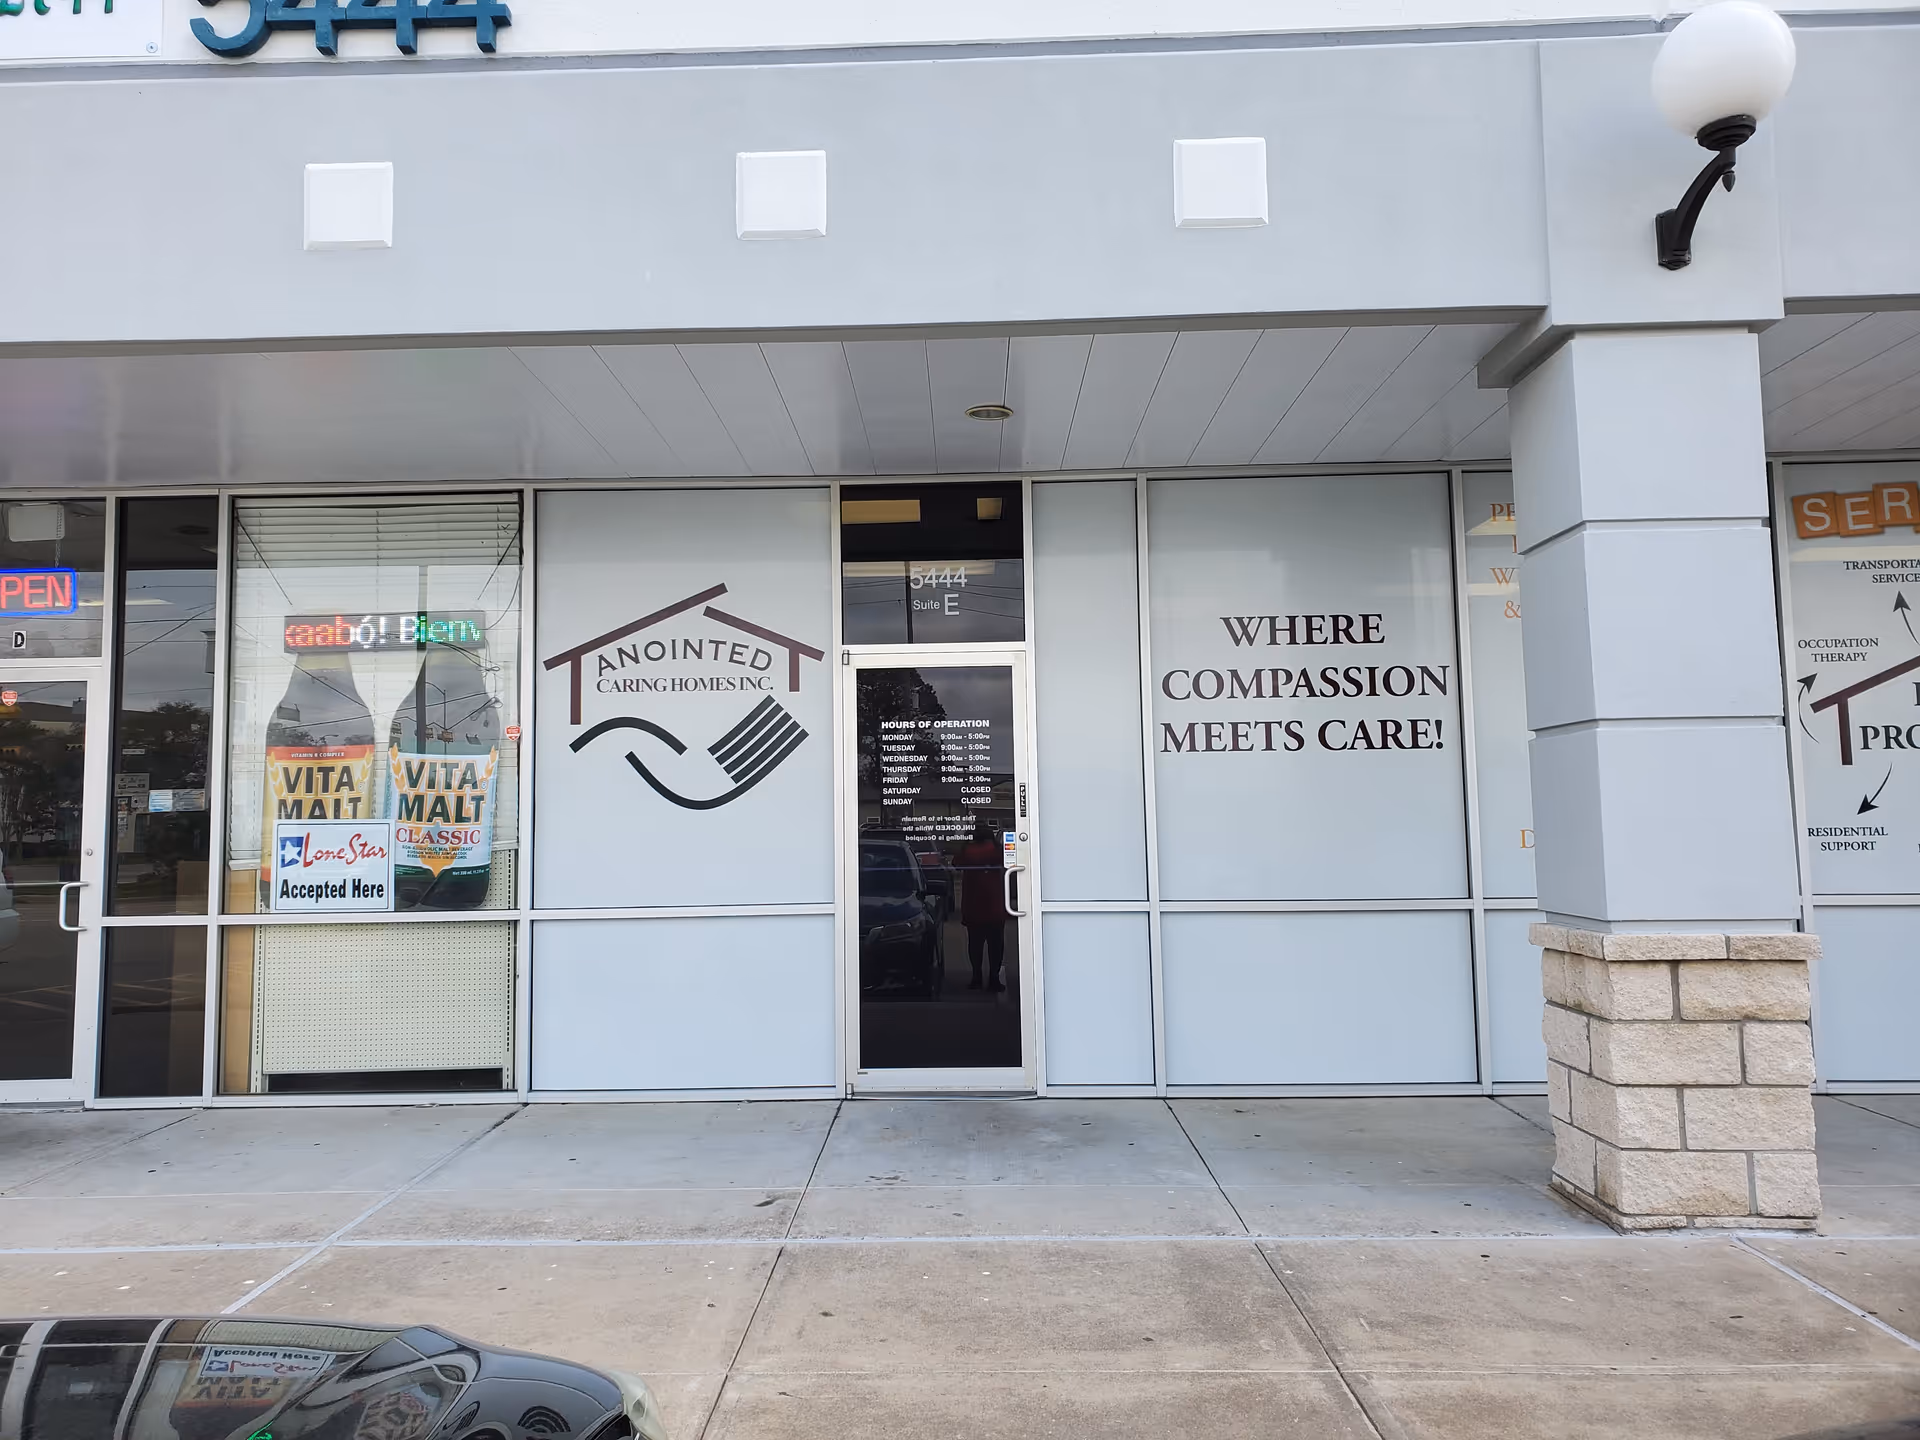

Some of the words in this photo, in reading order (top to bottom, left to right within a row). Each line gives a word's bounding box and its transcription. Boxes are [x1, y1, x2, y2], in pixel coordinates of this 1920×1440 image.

[910, 566, 968, 590] 5444
[913, 600, 940, 610] Suite
[944, 594, 960, 616] E
[14, 632, 25, 648] D
[1220, 614, 1385, 646] WHERE
[1798, 638, 1879, 648] OCCUPATION
[597, 638, 773, 677] ANOINTED
[1811, 652, 1868, 662] THERAPY
[596, 678, 668, 693] CARING
[671, 677, 736, 692] HOMES
[740, 676, 774, 690] INC.
[1162, 666, 1450, 700] COMPASSION
[934, 720, 990, 728] OPERATION
[1160, 720, 1305, 753] MEETS
[1318, 718, 1444, 751] CARE!
[282, 766, 356, 794] VITA
[405, 761, 480, 790] VITA
[278, 796, 362, 820] MALT
[398, 794, 484, 823] MALT
[396, 828, 480, 845] CLASSIC
[1808, 826, 1888, 837] RESIDENTIAL
[1820, 841, 1876, 852] SUPPORT
[280, 879, 346, 904] Accepted
[352, 878, 384, 898] Here
